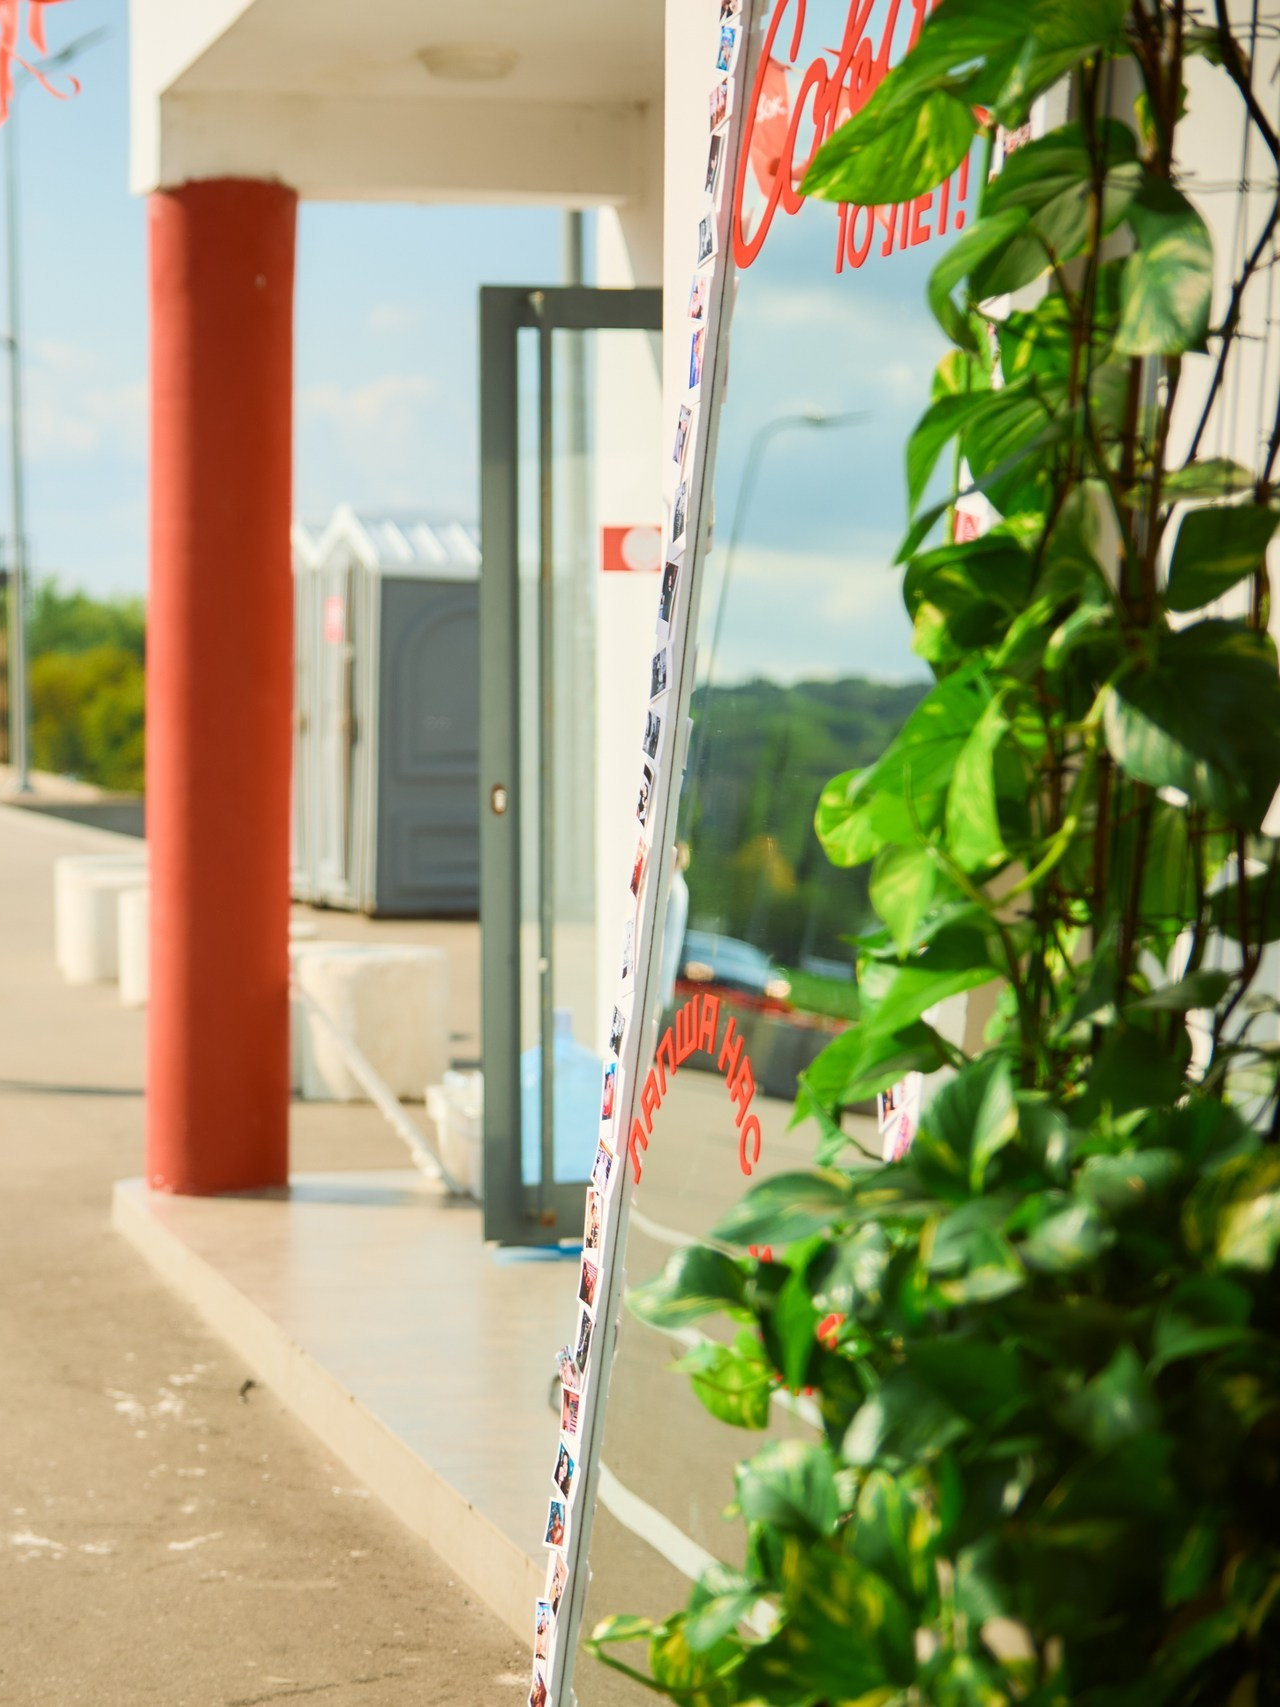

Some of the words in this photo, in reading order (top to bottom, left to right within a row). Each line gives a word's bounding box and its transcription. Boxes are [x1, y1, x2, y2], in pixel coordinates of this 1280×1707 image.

[835, 201, 874, 274] 10
[628, 993, 720, 1185] ЛАПША
[717, 1016, 761, 1176] НАС
